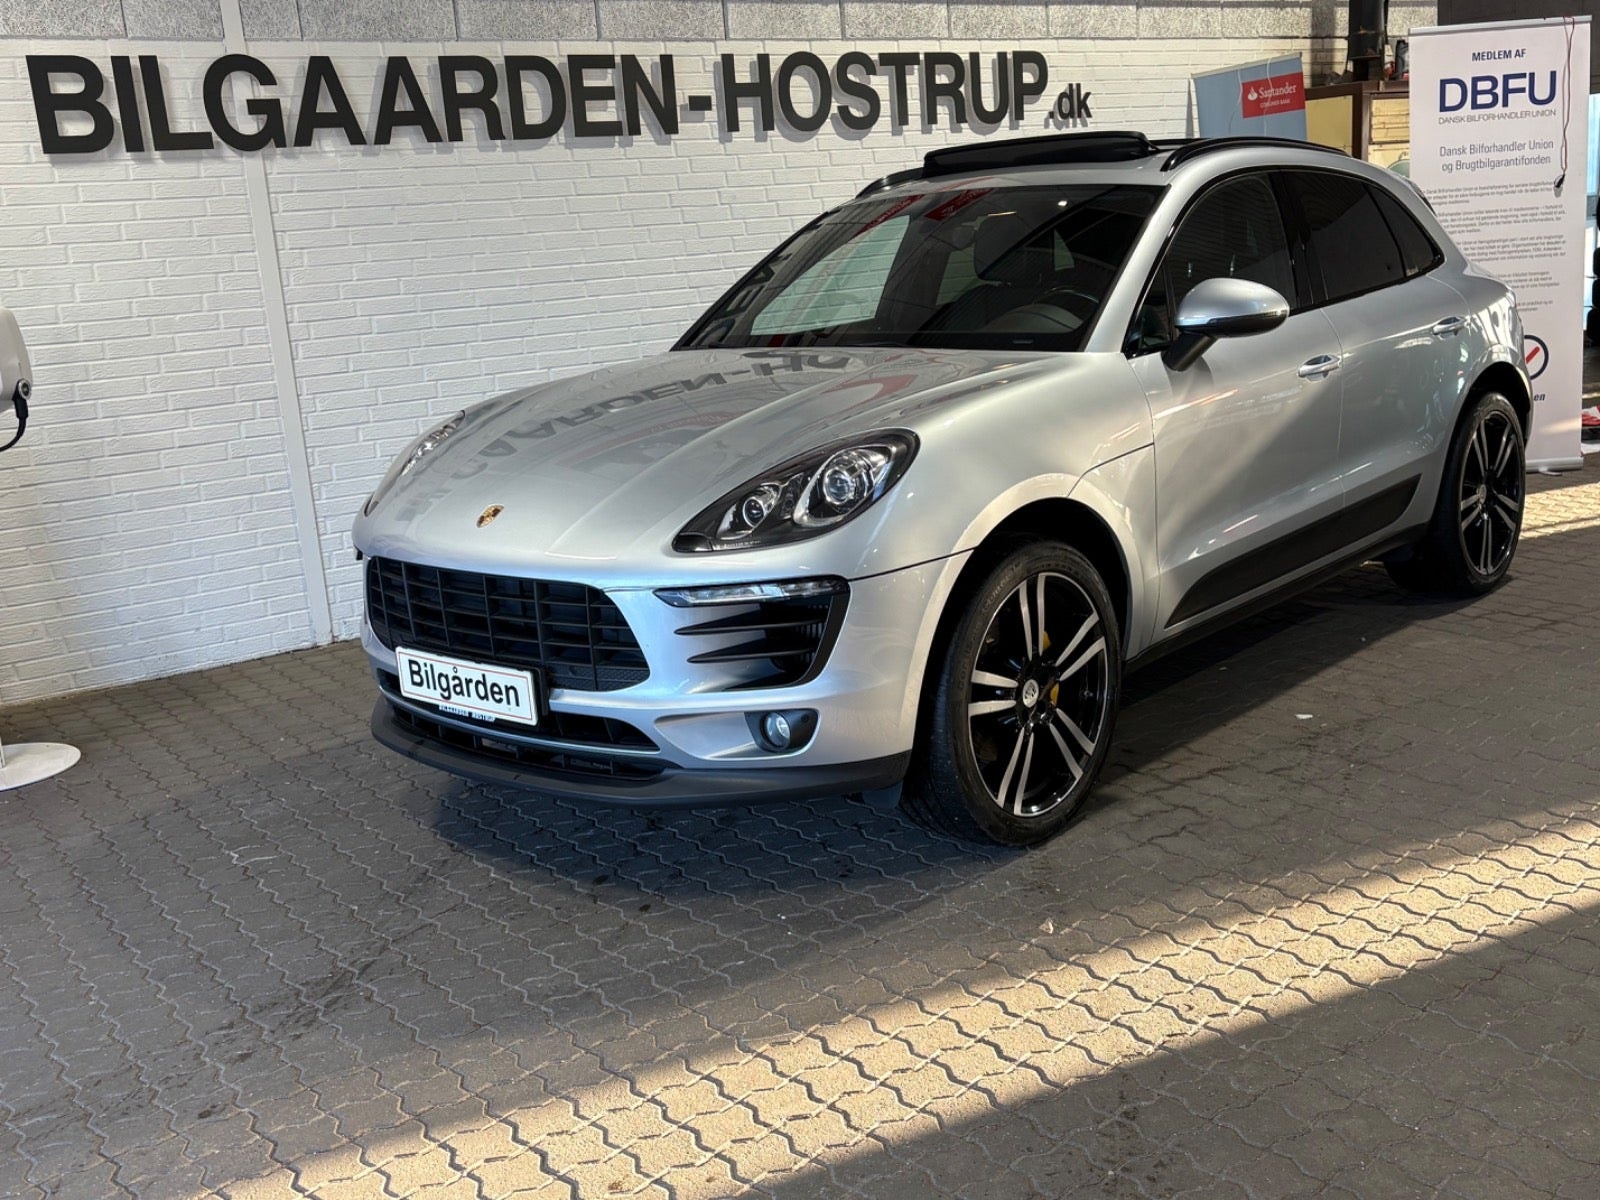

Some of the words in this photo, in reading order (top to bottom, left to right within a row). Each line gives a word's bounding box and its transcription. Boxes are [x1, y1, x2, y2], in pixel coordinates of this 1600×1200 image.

[1472, 50, 1512, 62] MEDLEM
[1514, 48, 1527, 59] AF
[1258, 82, 1297, 99] Santander
[1439, 70, 1557, 113] DBFU
[1438, 115, 1466, 125] DANSK
[1532, 109, 1556, 118] UNION
[1439, 145, 1467, 157] Dansk
[1469, 141, 1526, 155] Bilforhandler
[1528, 139, 1554, 150] Union
[1442, 162, 1453, 173] og
[1455, 154, 1551, 172] Brugtbilgarantifonden
[408, 659, 520, 708] Bilgården
